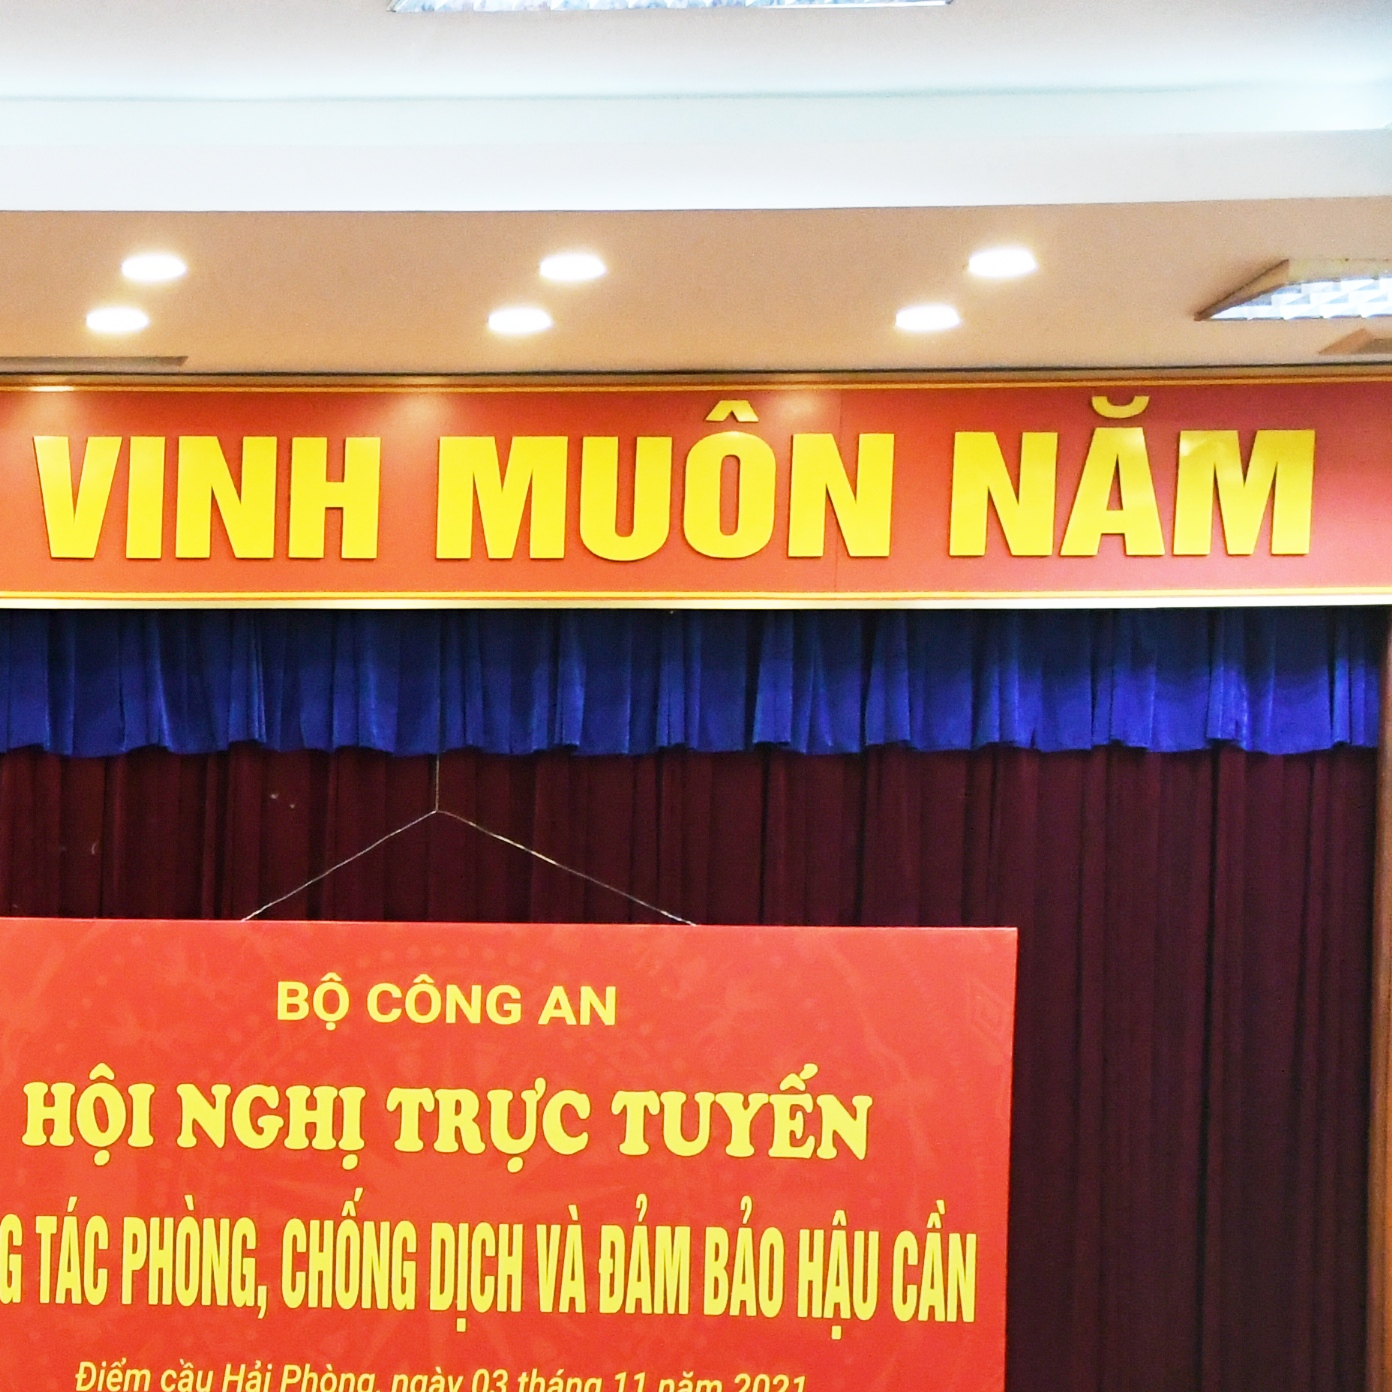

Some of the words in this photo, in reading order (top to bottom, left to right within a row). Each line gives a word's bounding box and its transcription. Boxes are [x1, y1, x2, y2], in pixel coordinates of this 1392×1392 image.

[31, 434, 382, 559] VINH
[435, 400, 895, 562] MUÔN
[948, 396, 1316, 557] NĂM
[276, 972, 350, 1031] BỘ
[366, 973, 524, 1026] CÔNG
[537, 984, 618, 1027] AN
[21, 1063, 156, 1167] HỘI
[175, 1083, 367, 1171] NGHỊ
[384, 1076, 591, 1174] TRỰC
[609, 1062, 874, 1162] TUYẾN
[35, 1195, 109, 1306] TÁC
[121, 1194, 268, 1320] PHÒNG,
[281, 1186, 418, 1312] CHỐNG
[429, 1222, 524, 1333] DỊCH
[535, 1205, 587, 1314] VÀ
[597, 1192, 691, 1316] ĐẢM
[703, 1195, 785, 1318] BẢO
[797, 1209, 880, 1341] HẬU
[891, 1199, 978, 1323] CẦN
[74, 1356, 152, 1392] Điểm
